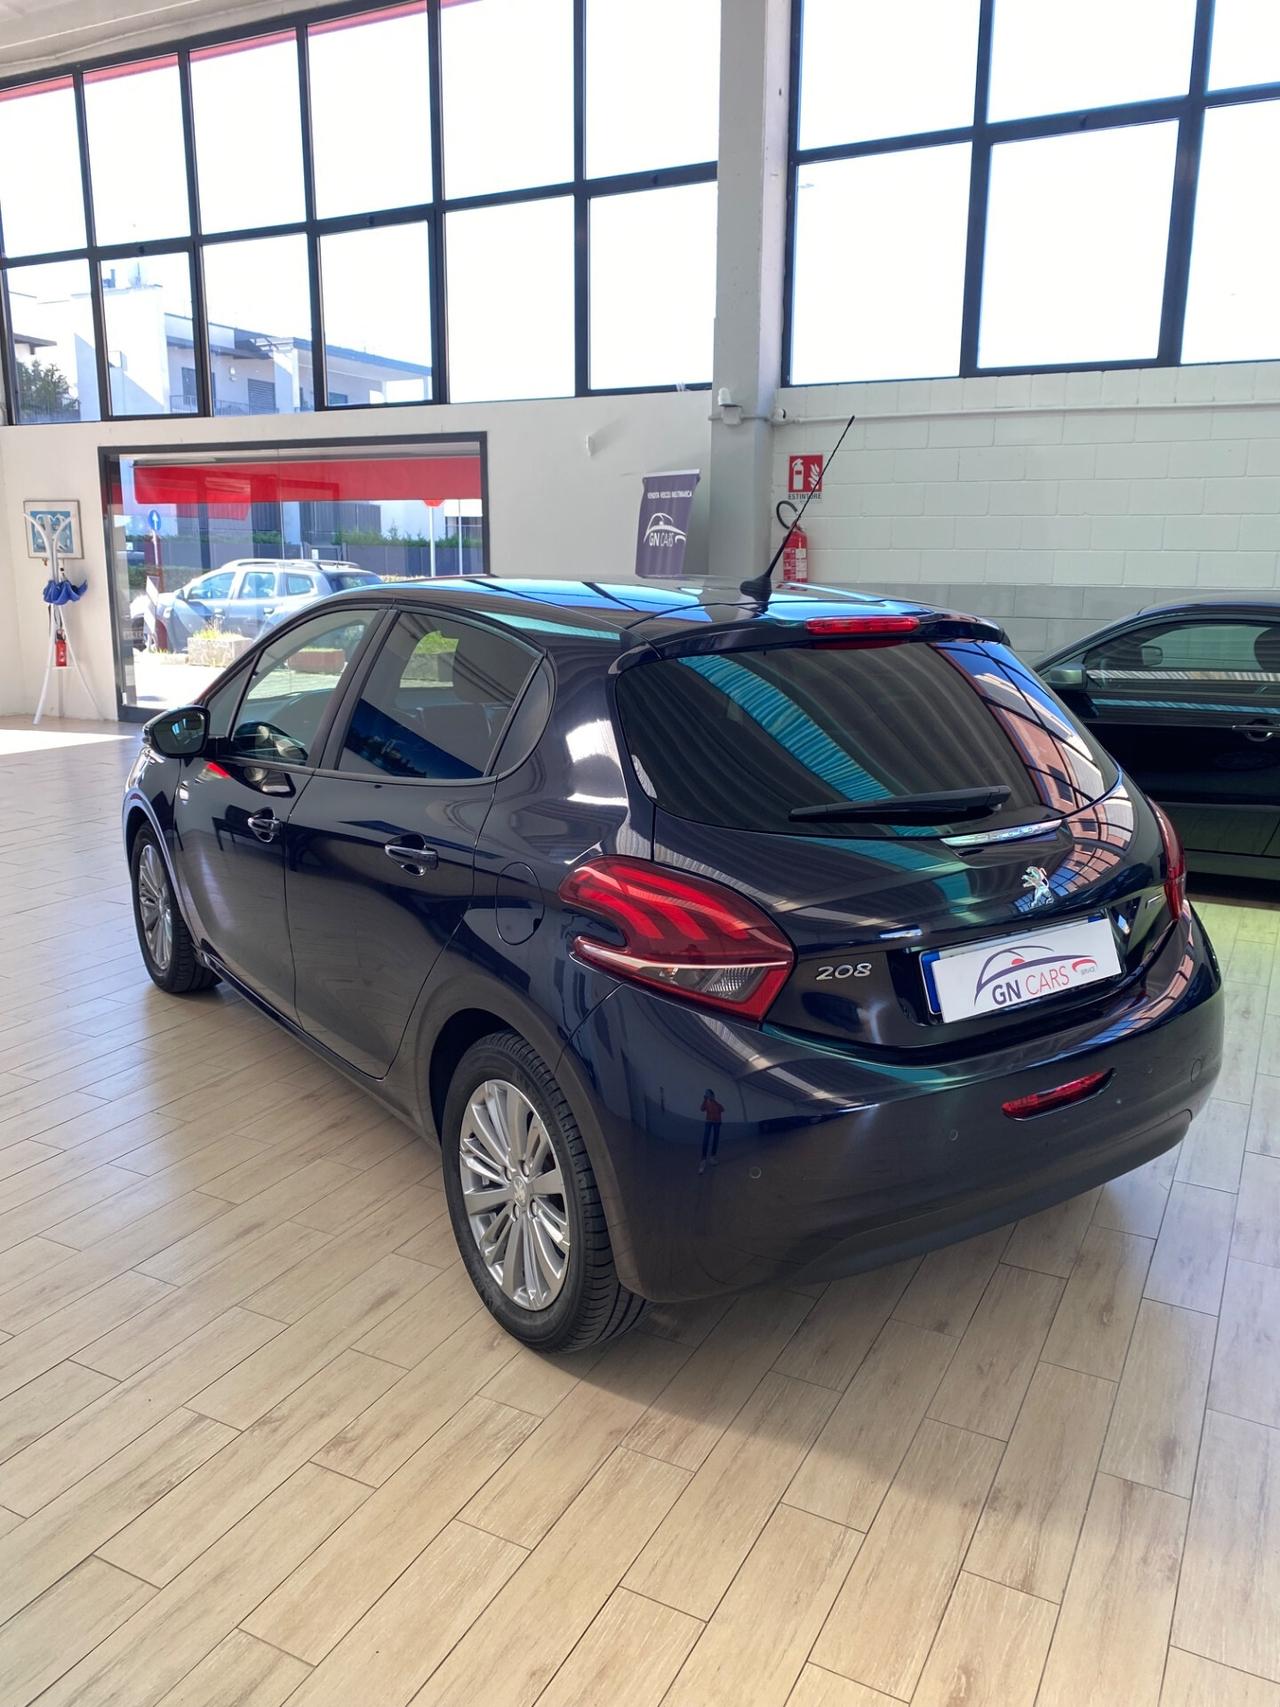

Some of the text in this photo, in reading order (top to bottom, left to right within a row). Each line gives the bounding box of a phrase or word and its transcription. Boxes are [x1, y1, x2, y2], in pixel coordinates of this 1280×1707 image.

[649, 532, 660, 547] GN
[816, 962, 872, 981] 208
[992, 965, 1070, 1005] GN CARS
